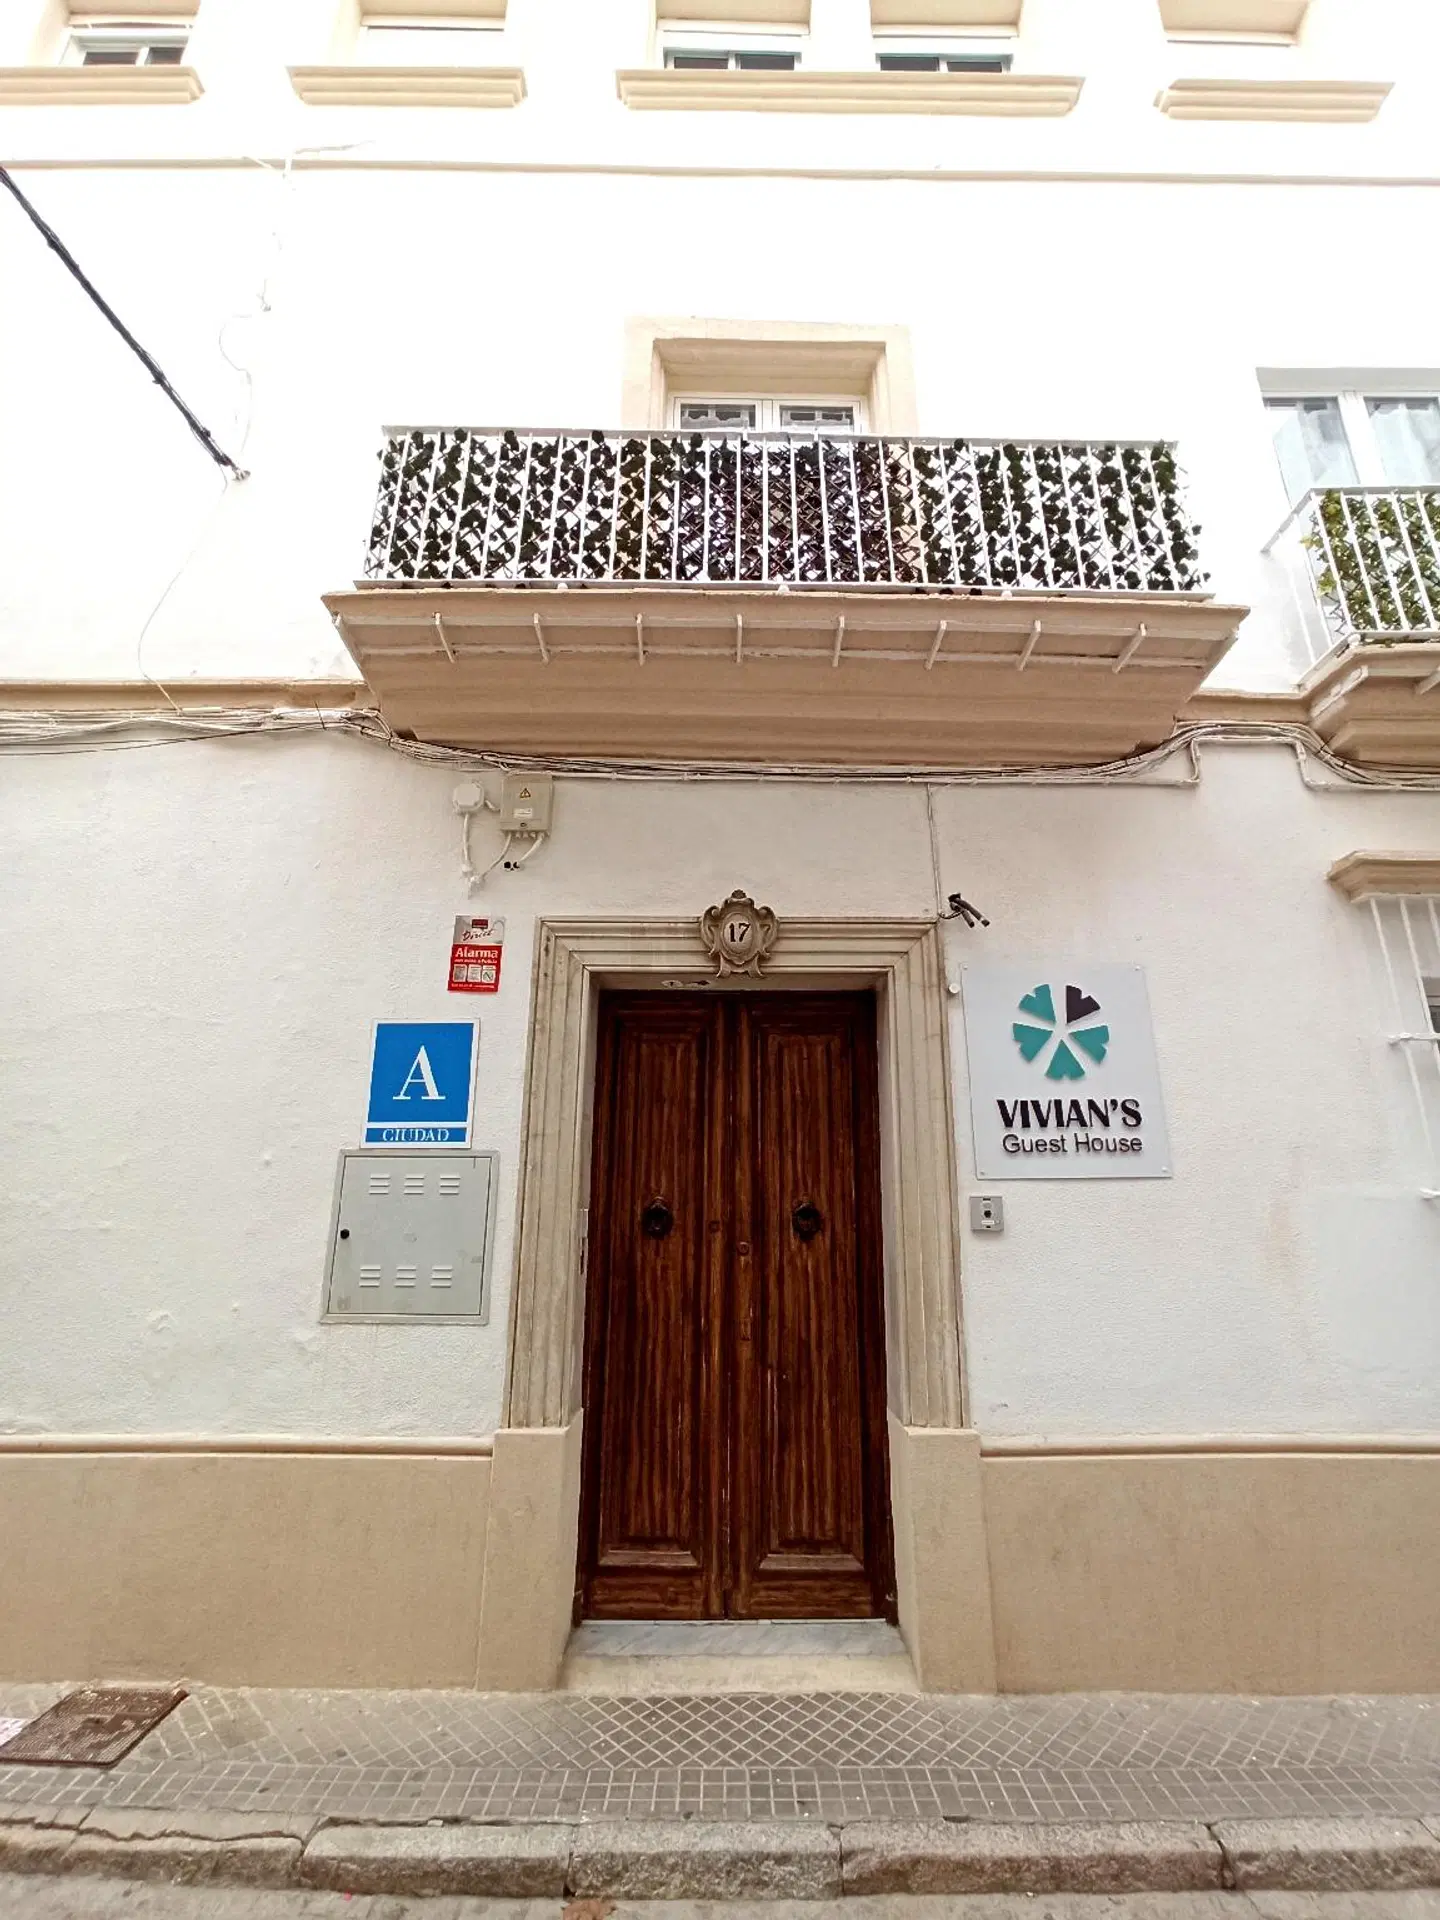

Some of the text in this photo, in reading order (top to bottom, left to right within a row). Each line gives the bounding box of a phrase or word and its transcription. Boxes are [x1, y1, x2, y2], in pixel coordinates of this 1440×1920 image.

[729, 922, 750, 942] 17
[455, 947, 498, 958] Alarma
[392, 1044, 446, 1100] A
[997, 1099, 1143, 1128] VIVIAN'S
[382, 1128, 450, 1141] CIUDAD
[1002, 1133, 1143, 1153] Guest House
